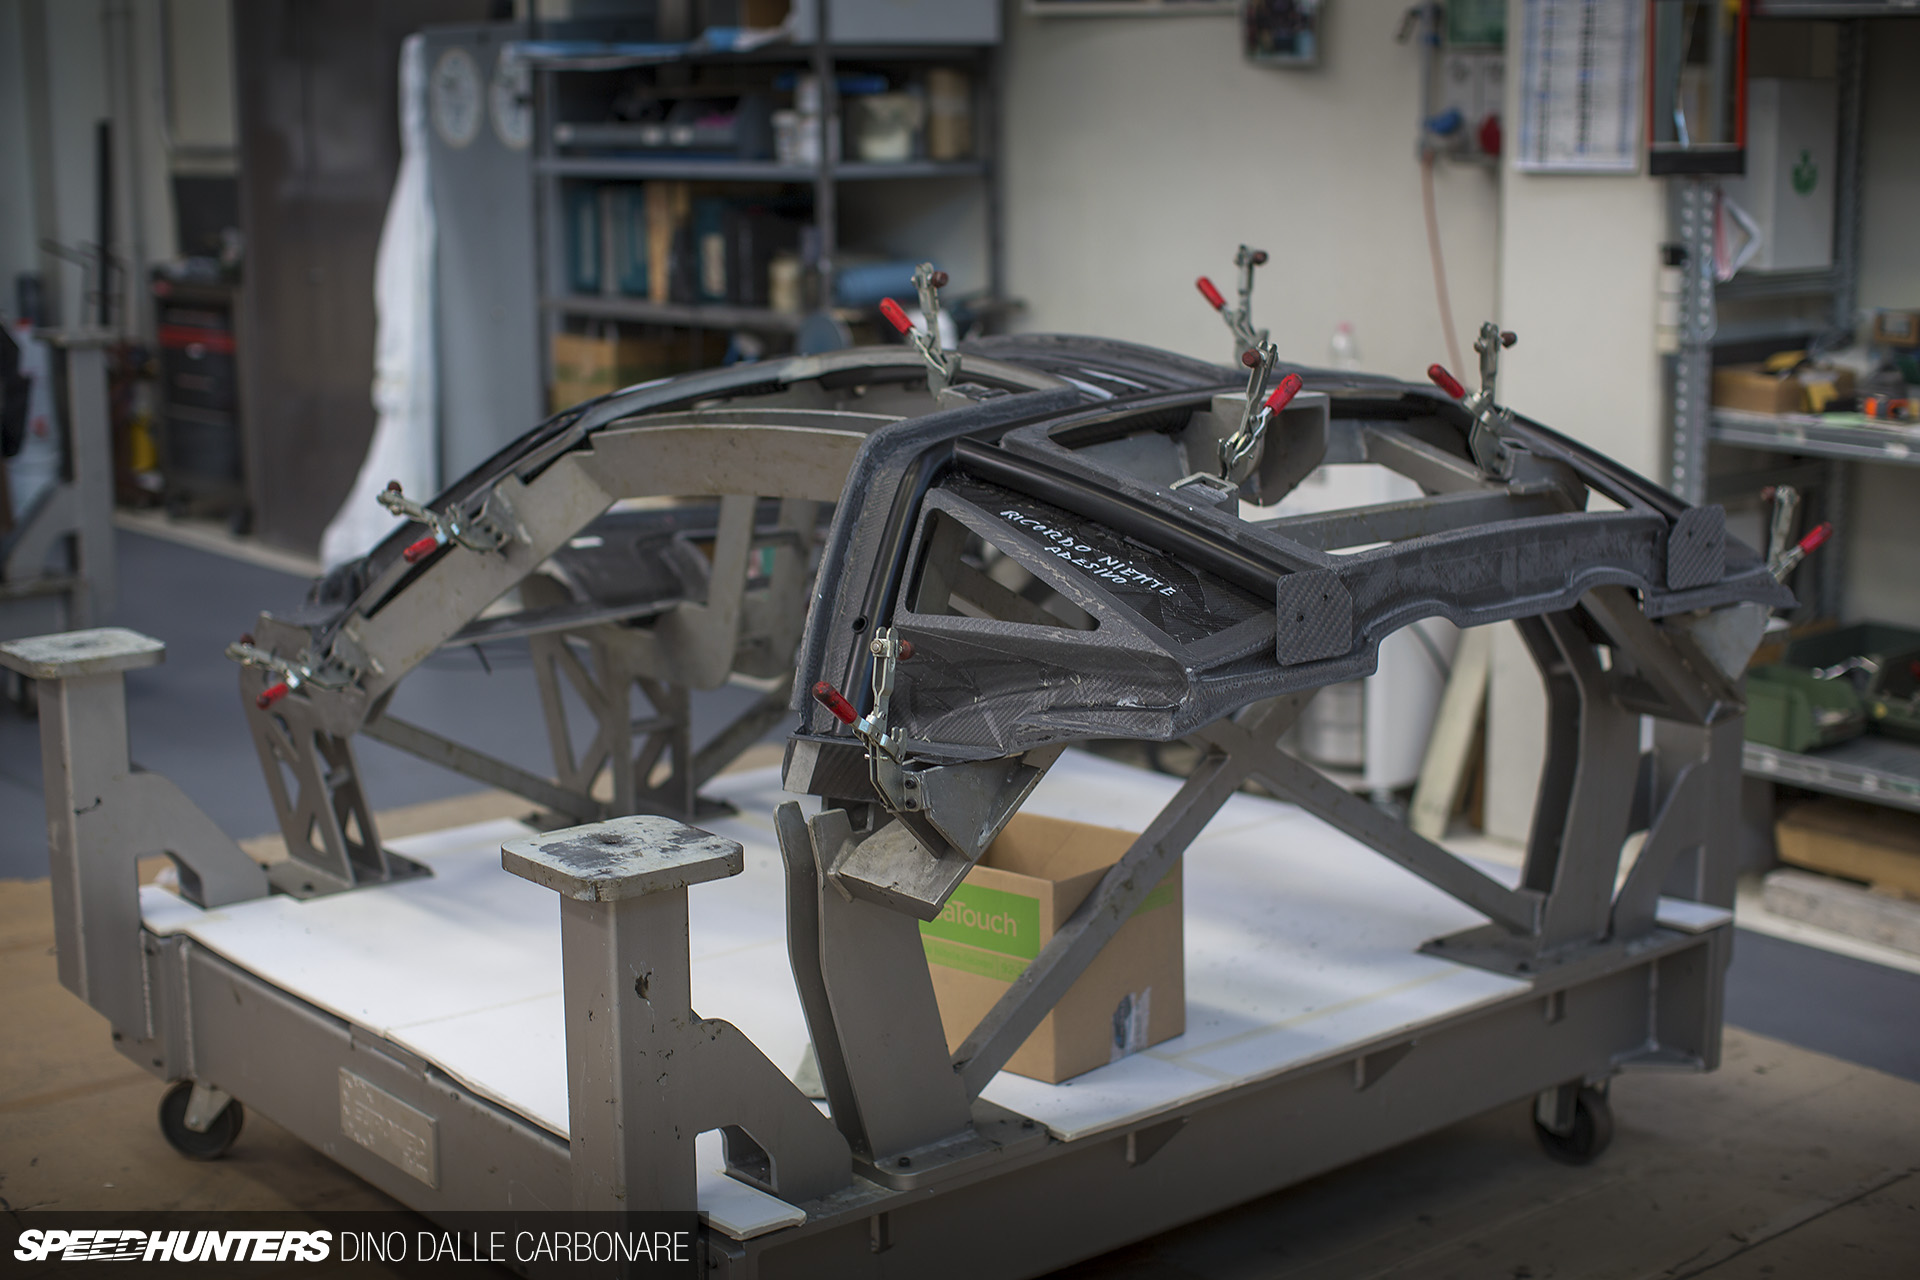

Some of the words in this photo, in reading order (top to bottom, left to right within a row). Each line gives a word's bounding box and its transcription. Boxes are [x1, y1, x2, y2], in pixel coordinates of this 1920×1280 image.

[1000, 510, 1092, 553] RICORDO
[1098, 556, 1177, 597] NIENTE
[1044, 546, 1127, 585] ADESIVO
[936, 900, 1017, 937] aTouch
